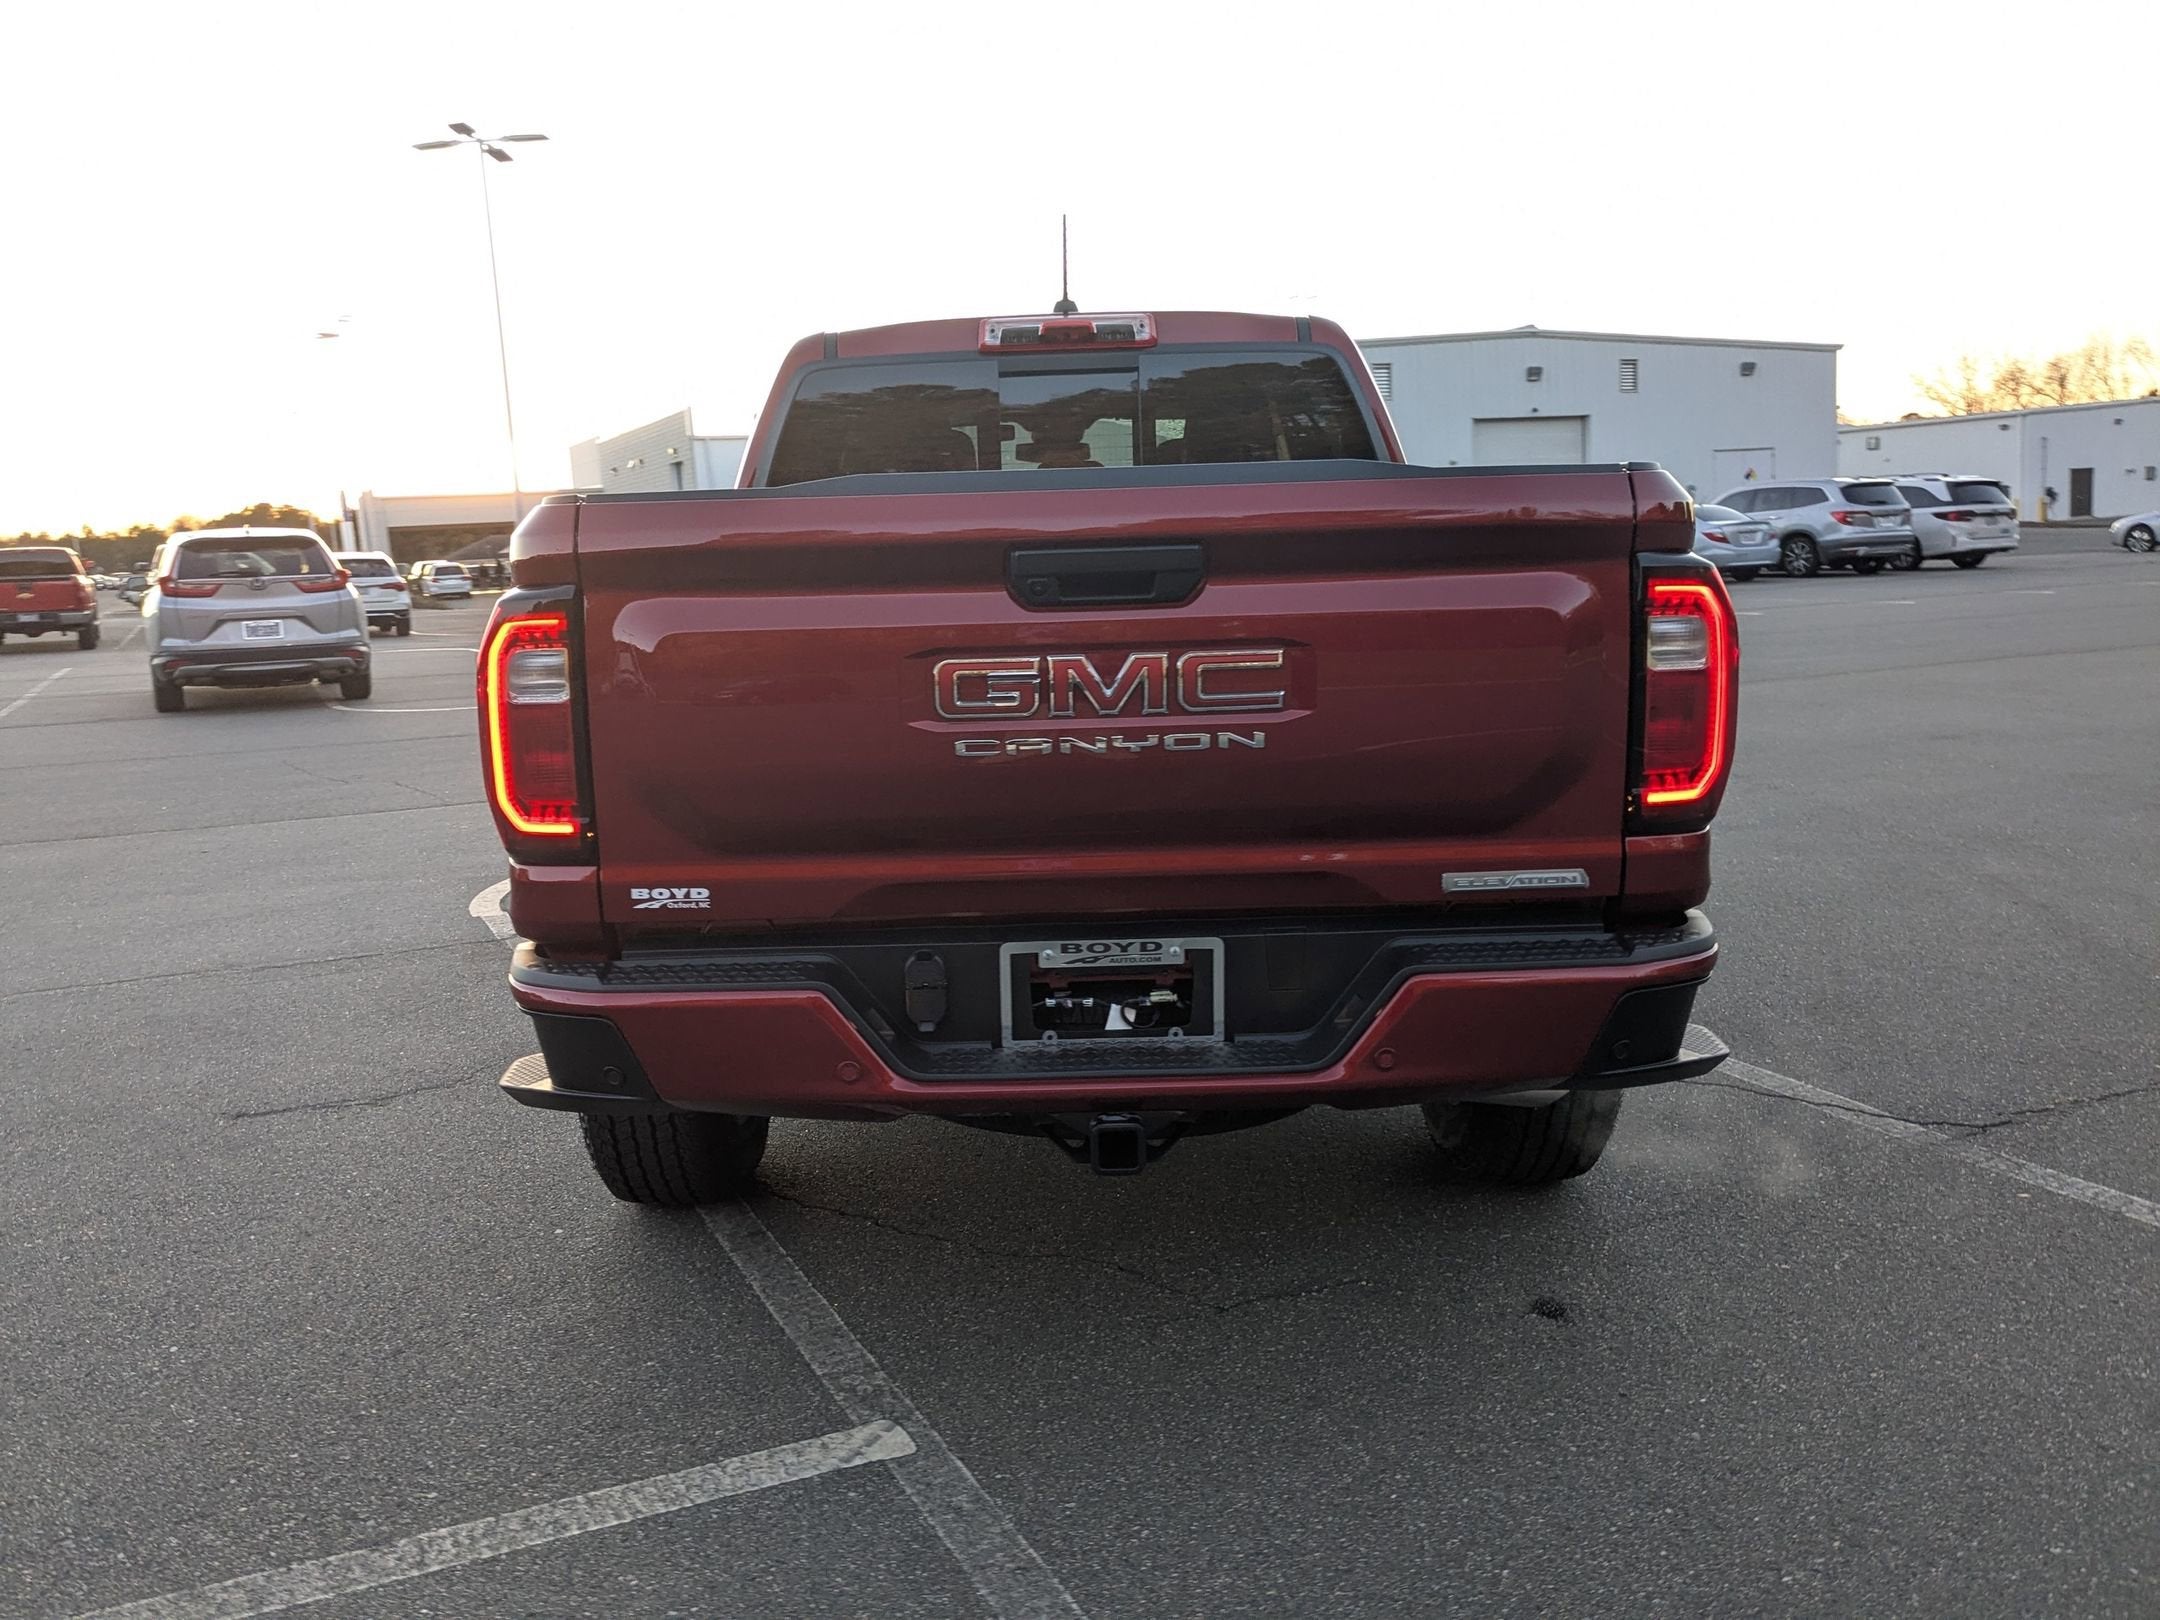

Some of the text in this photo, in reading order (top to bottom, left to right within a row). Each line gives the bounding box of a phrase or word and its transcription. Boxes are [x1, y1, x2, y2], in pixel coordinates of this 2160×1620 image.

[932, 649, 1285, 719] GMC
[954, 731, 1265, 757] CANYON
[1453, 874, 1578, 888] ELEVATION
[630, 887, 710, 900] BOYD
[1060, 941, 1163, 954] BOYD
[1108, 956, 1163, 964] AUTO.COM
